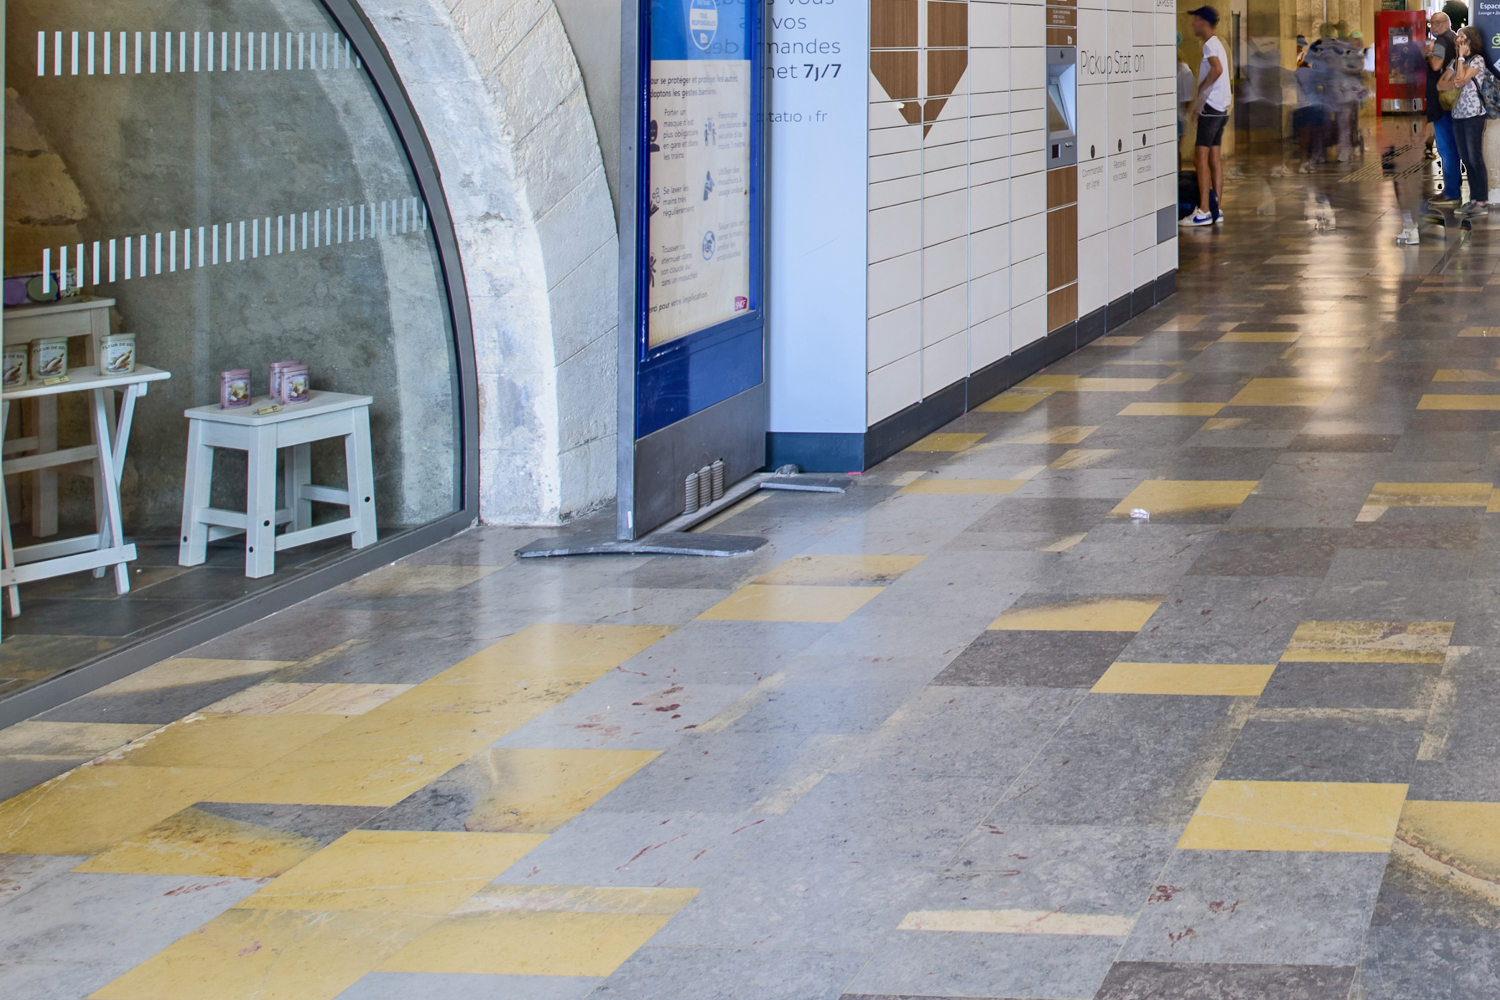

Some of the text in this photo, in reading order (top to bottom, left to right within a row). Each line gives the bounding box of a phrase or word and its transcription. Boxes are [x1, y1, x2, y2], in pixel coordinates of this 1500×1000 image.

[772, 17, 807, 30] vos
[766, 38, 841, 54] mandes
[1080, 50, 1145, 80] Pickup Staton
[766, 64, 798, 78] net
[668, 76, 690, 86] protéger
[650, 89, 671, 100] doptons
[682, 89, 697, 99] gestes
[664, 108, 679, 117] Porter
[663, 120, 682, 128] masque
[663, 129, 699, 141] plus obligatoire
[670, 143, 681, 151] gare
[663, 186, 670, 195] Se
[671, 185, 682, 193] laver
[663, 198, 677, 206] mains
[662, 245, 680, 253] Tousser
[649, 304, 658, 314] erci
[659, 302, 670, 313] pour
[735, 299, 746, 310] SNCF
